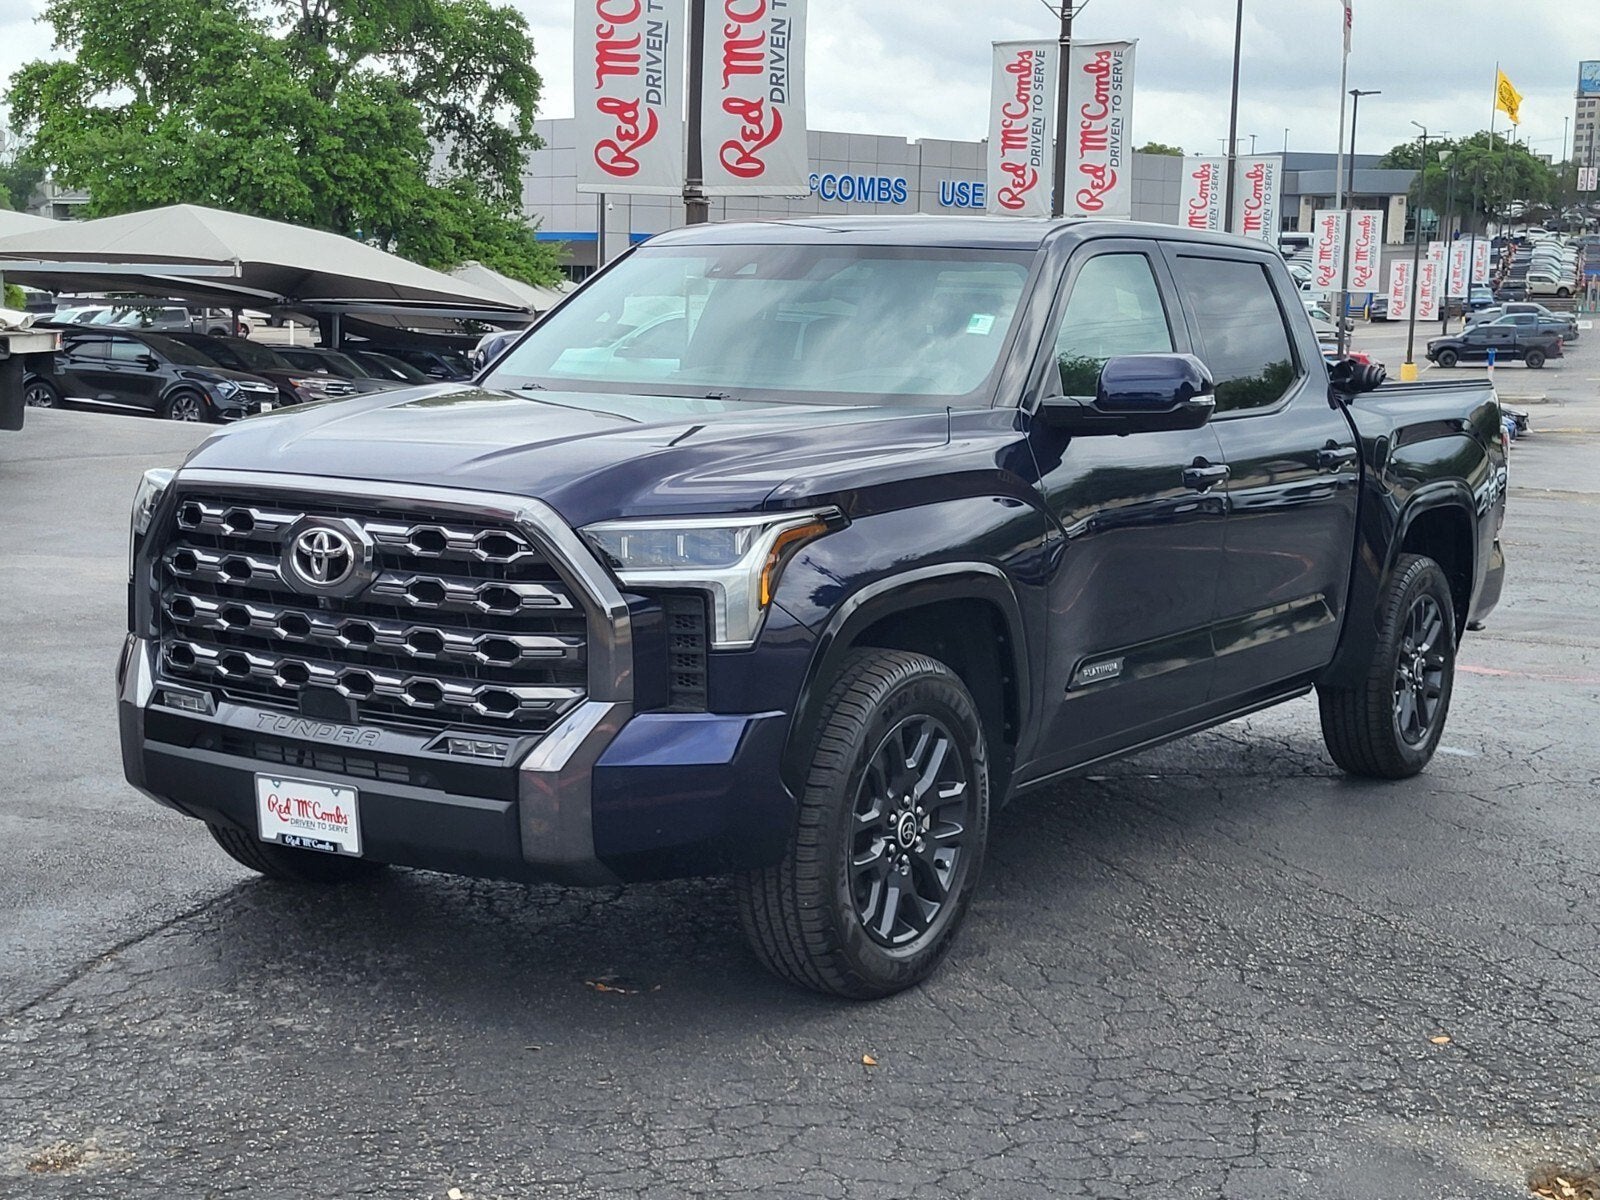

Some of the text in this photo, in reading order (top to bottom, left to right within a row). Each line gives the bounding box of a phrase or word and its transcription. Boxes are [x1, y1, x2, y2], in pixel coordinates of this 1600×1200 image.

[646, 20, 664, 105] DRIVEN
[770, 18, 787, 104] DRIVEN
[594, 96, 659, 177] Red
[719, 96, 783, 178] Red
[997, 50, 1038, 210] Red McCombs
[1030, 50, 1046, 167] DRIVEN TO SERVE
[1076, 50, 1117, 212] Red McCombs
[1109, 50, 1124, 168] DRIVEN TO SERVE
[939, 180, 986, 208] USE
[1188, 163, 1211, 229] McCombs
[1209, 163, 1220, 230] IVEN TO SERVE
[1243, 163, 1265, 235] McCombs
[1262, 163, 1274, 242] DRIVEN TO SERVE
[1316, 215, 1336, 287] Red McCombs
[1353, 215, 1373, 288] Red McCombs
[256, 712, 382, 747] TUNDRA
[267, 793, 348, 825] Red McCombs
[285, 834, 301, 847] Red
[290, 818, 349, 834] DRIVEN TO SERVE
